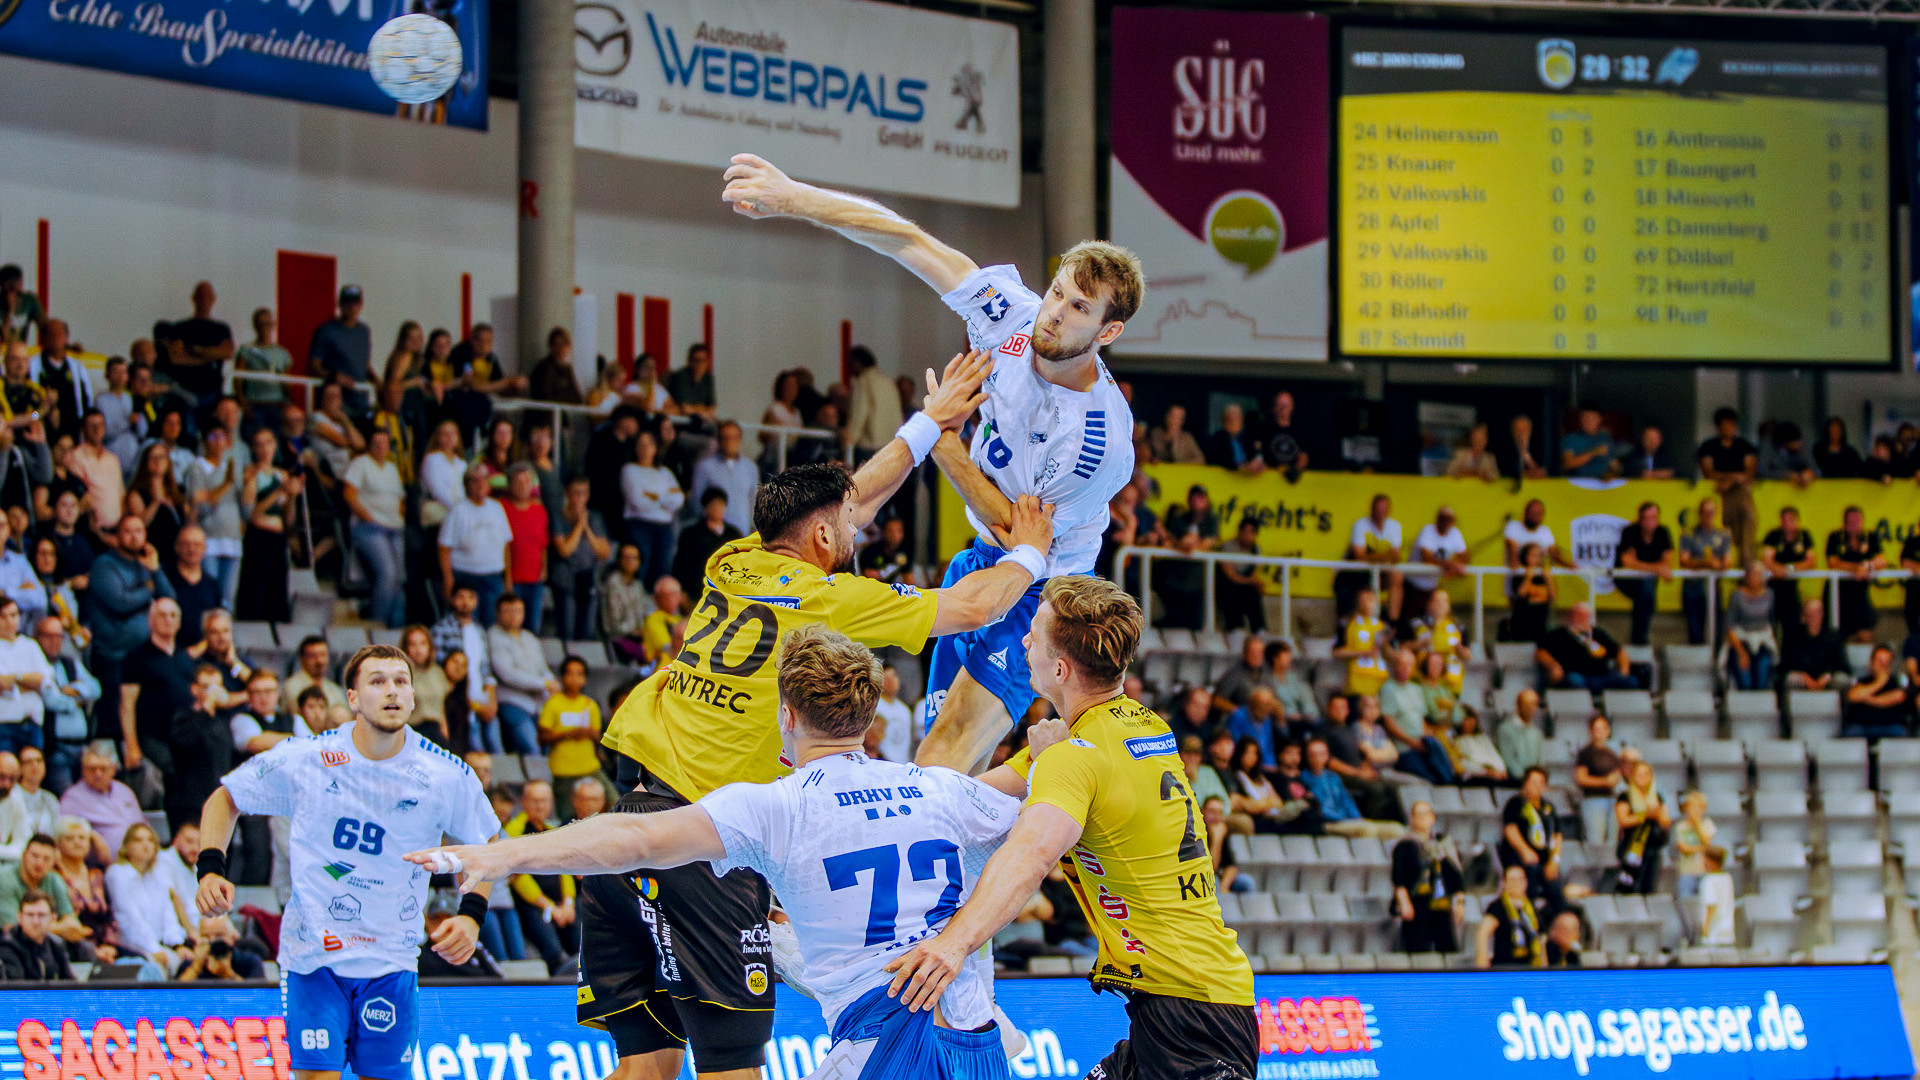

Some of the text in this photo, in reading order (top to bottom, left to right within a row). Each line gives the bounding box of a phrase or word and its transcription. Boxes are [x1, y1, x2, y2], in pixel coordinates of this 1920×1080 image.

[695, 20, 787, 55] Automobile
[646, 11, 928, 123] WEBERPALS
[577, 87, 639, 109] azda
[878, 125, 924, 152] GmbH
[1354, 123, 1378, 141] 24
[933, 140, 1009, 164] PEUGEOT
[1355, 154, 1378, 172] 25
[1387, 154, 1456, 173] Knauer
[1388, 184, 1488, 203] Valkovskis
[1390, 243, 1489, 263] Valkovskis
[1391, 330, 1466, 349] Schmidt
[675, 589, 779, 678] 20
[666, 670, 753, 714] ONTREC
[323, 751, 347, 765] DB
[834, 786, 924, 807] DRHV 06
[332, 816, 386, 856] 69
[822, 838, 964, 948] 72
[740, 923, 770, 943] RÖS
[366, 1008, 392, 1022] MERZ
[1259, 997, 1371, 1055] ASSER
[301, 1028, 329, 1050] 69
[1498, 990, 1808, 1077] shop.sagasser.de
